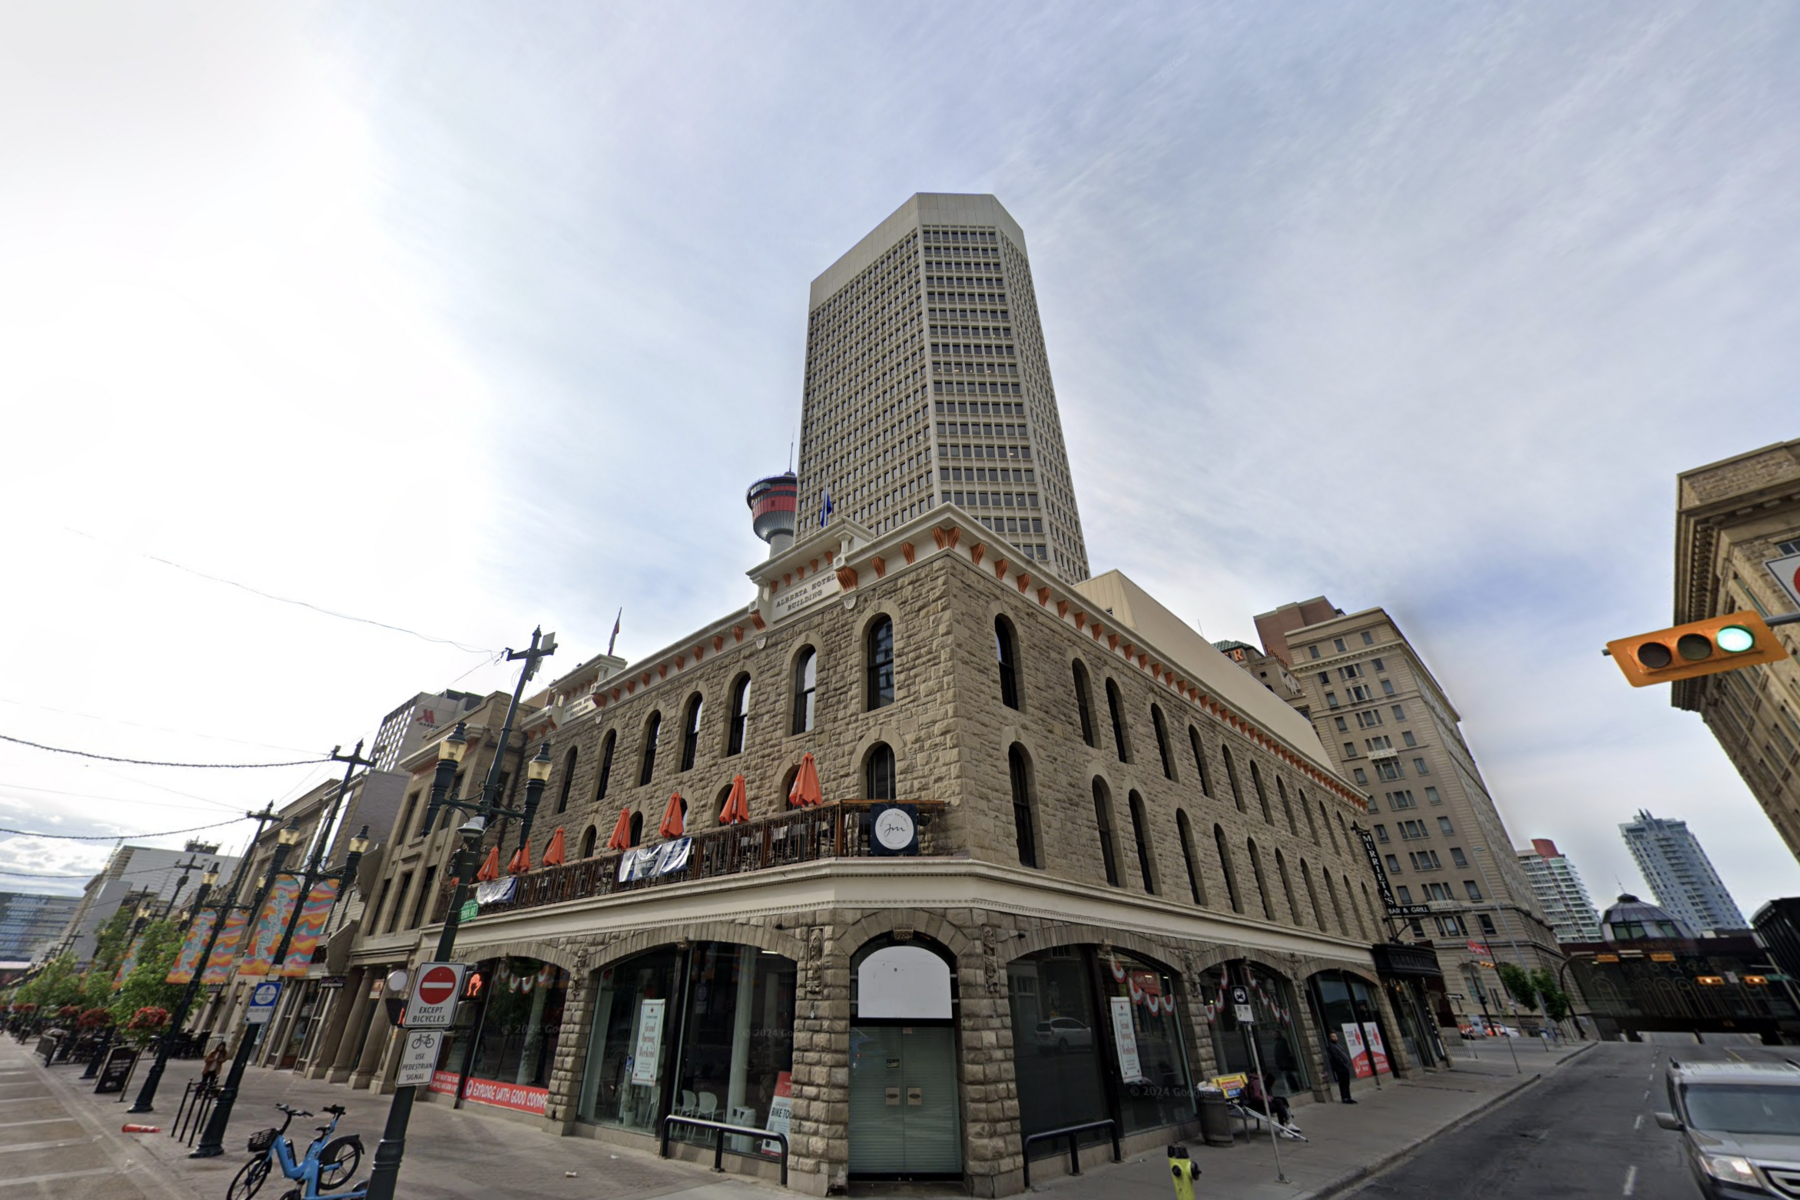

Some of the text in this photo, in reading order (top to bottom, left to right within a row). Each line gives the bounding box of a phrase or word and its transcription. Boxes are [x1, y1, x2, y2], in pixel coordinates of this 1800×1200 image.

[776, 573, 836, 608] ALBERTA HOTEL
[787, 589, 823, 611] BUILDING
[418, 721, 440, 729] MARRIO
[1362, 834, 1394, 905] MURRIETA'S
[418, 1006, 443, 1014] EXCEPT
[412, 1015, 445, 1023] BICYCLES
[402, 1062, 433, 1070] PEDESTRIAN
[406, 1073, 424, 1081] SIGNAL
[473, 1082, 496, 1100] EXPLORE
[496, 1087, 510, 1102] WITH
[510, 1089, 527, 1106] GOOD
[771, 1107, 783, 1118] BIKE
